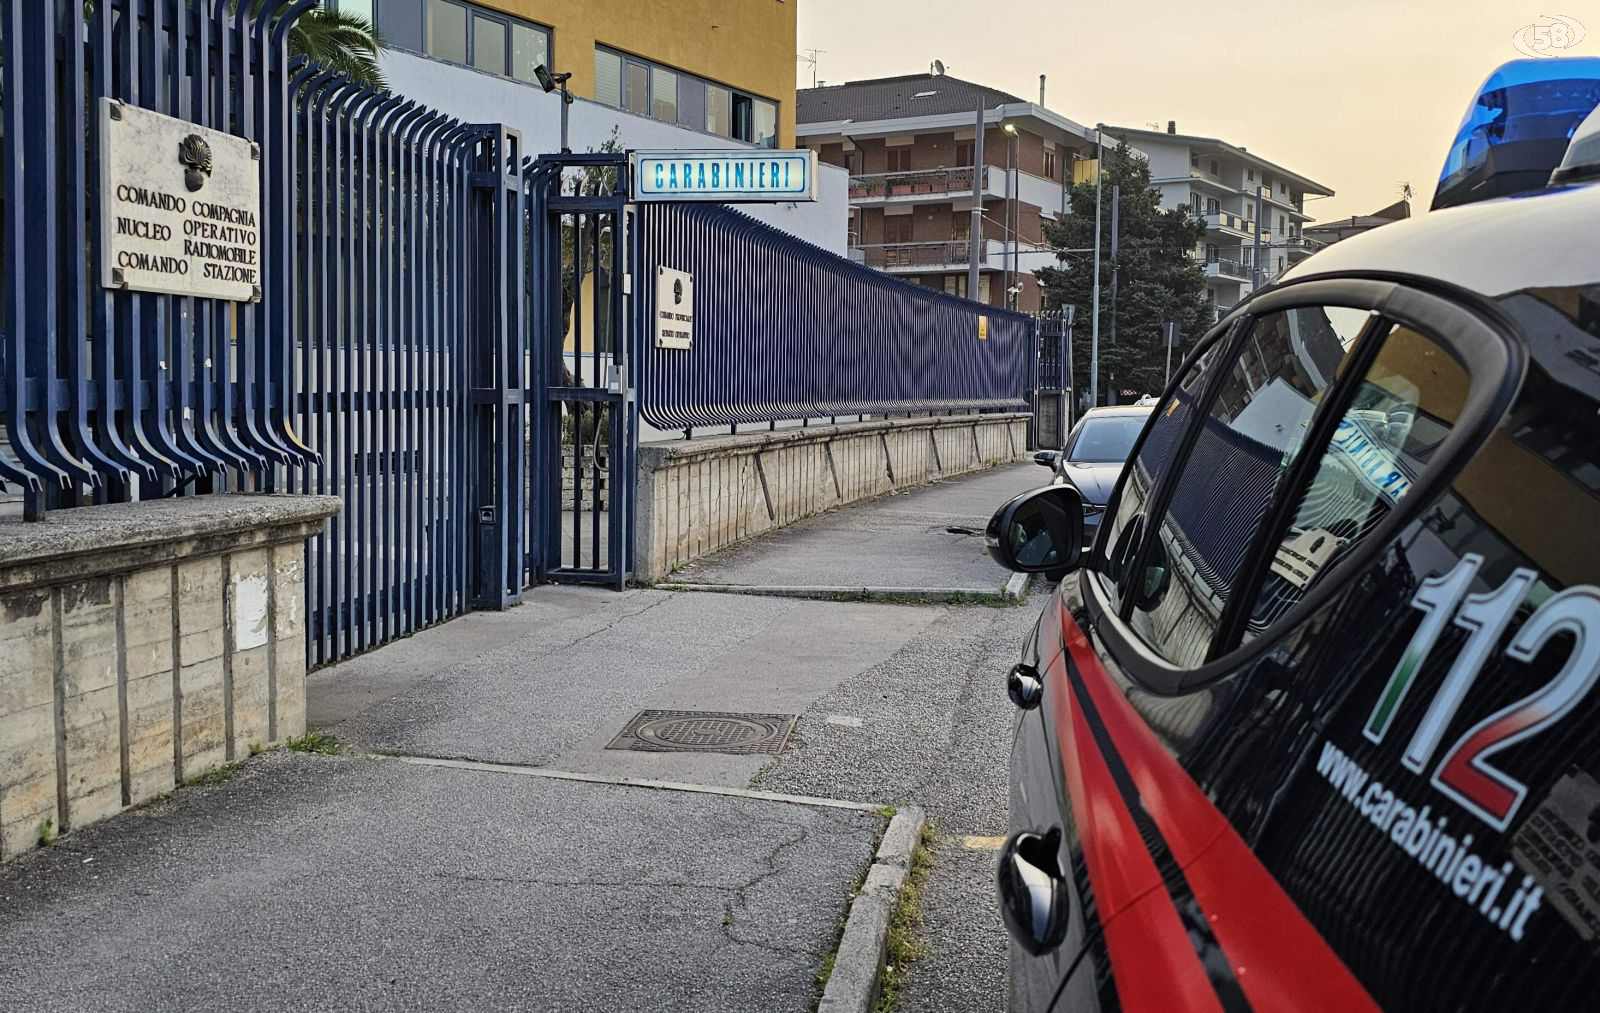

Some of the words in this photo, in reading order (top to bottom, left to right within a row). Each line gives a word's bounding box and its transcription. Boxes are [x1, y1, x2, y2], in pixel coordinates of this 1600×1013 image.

[655, 162, 790, 189] CARABINIERI
[117, 184, 186, 213] COMANDO
[192, 201, 256, 228] COMPAGNIA
[117, 217, 171, 241] NUCLEO
[183, 220, 256, 246] OPERATIVO
[118, 251, 188, 275] COMANDO
[203, 263, 257, 285] STAZIONE
[184, 239, 257, 265] RADIOMOBILE
[1363, 552, 1600, 832] 112
[1316, 741, 1544, 942] www.carabinieri.it
